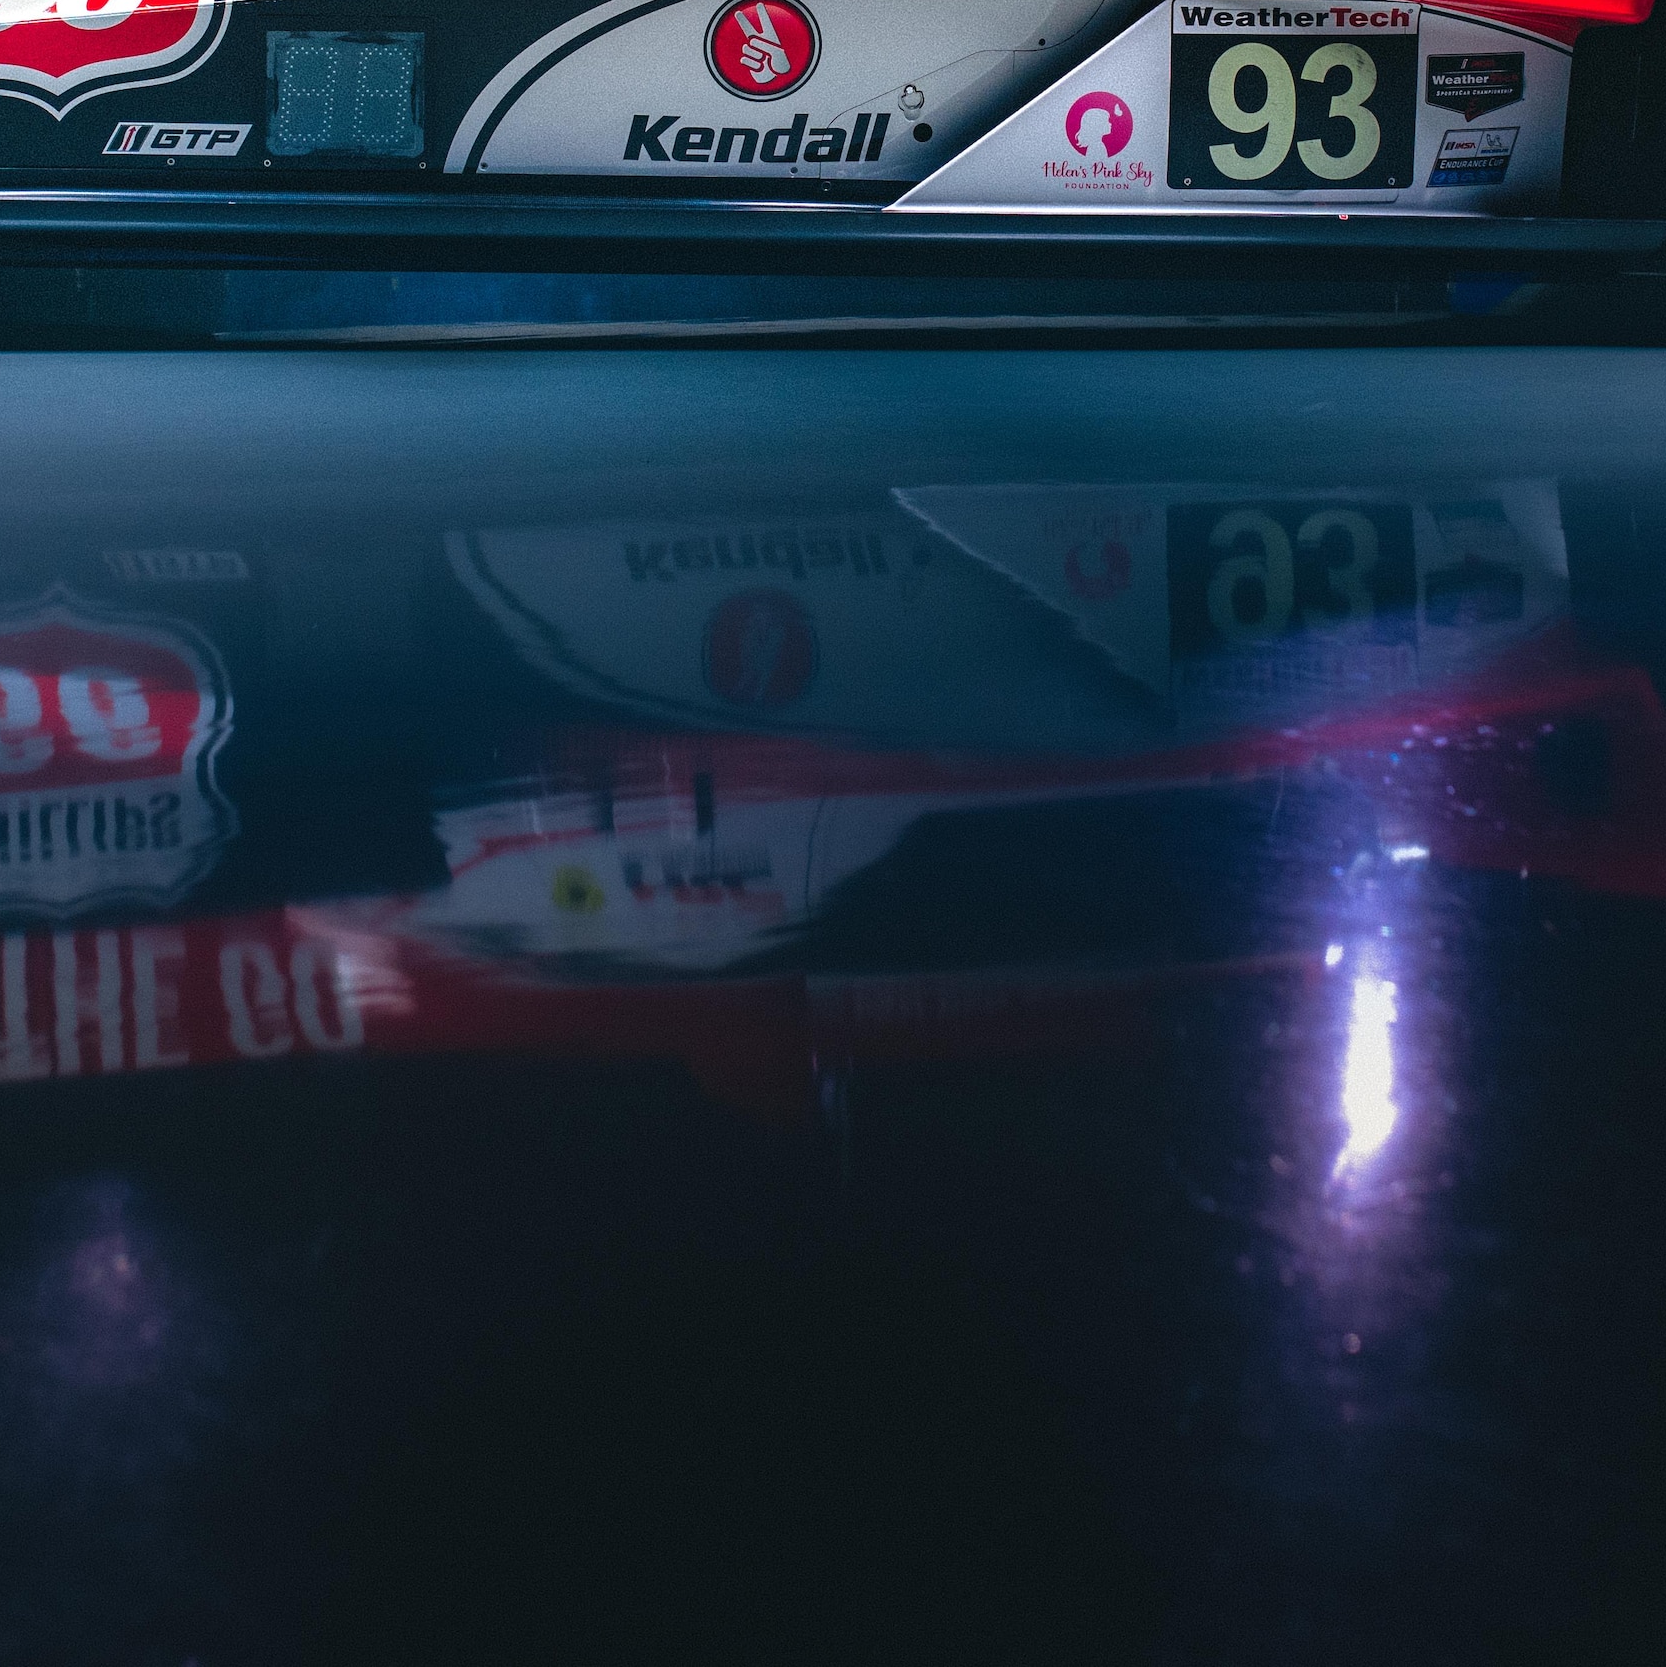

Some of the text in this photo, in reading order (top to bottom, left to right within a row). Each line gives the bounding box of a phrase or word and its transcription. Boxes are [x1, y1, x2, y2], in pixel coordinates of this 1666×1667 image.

[1181, 6, 1410, 28] WeatherTech
[1208, 42, 1381, 180] 93
[149, 129, 241, 149] GTP
[623, 113, 891, 163] Kendall
[1042, 161, 1154, 188] Helen's Pink Sky
[1064, 182, 1130, 190] FOUNDATION
